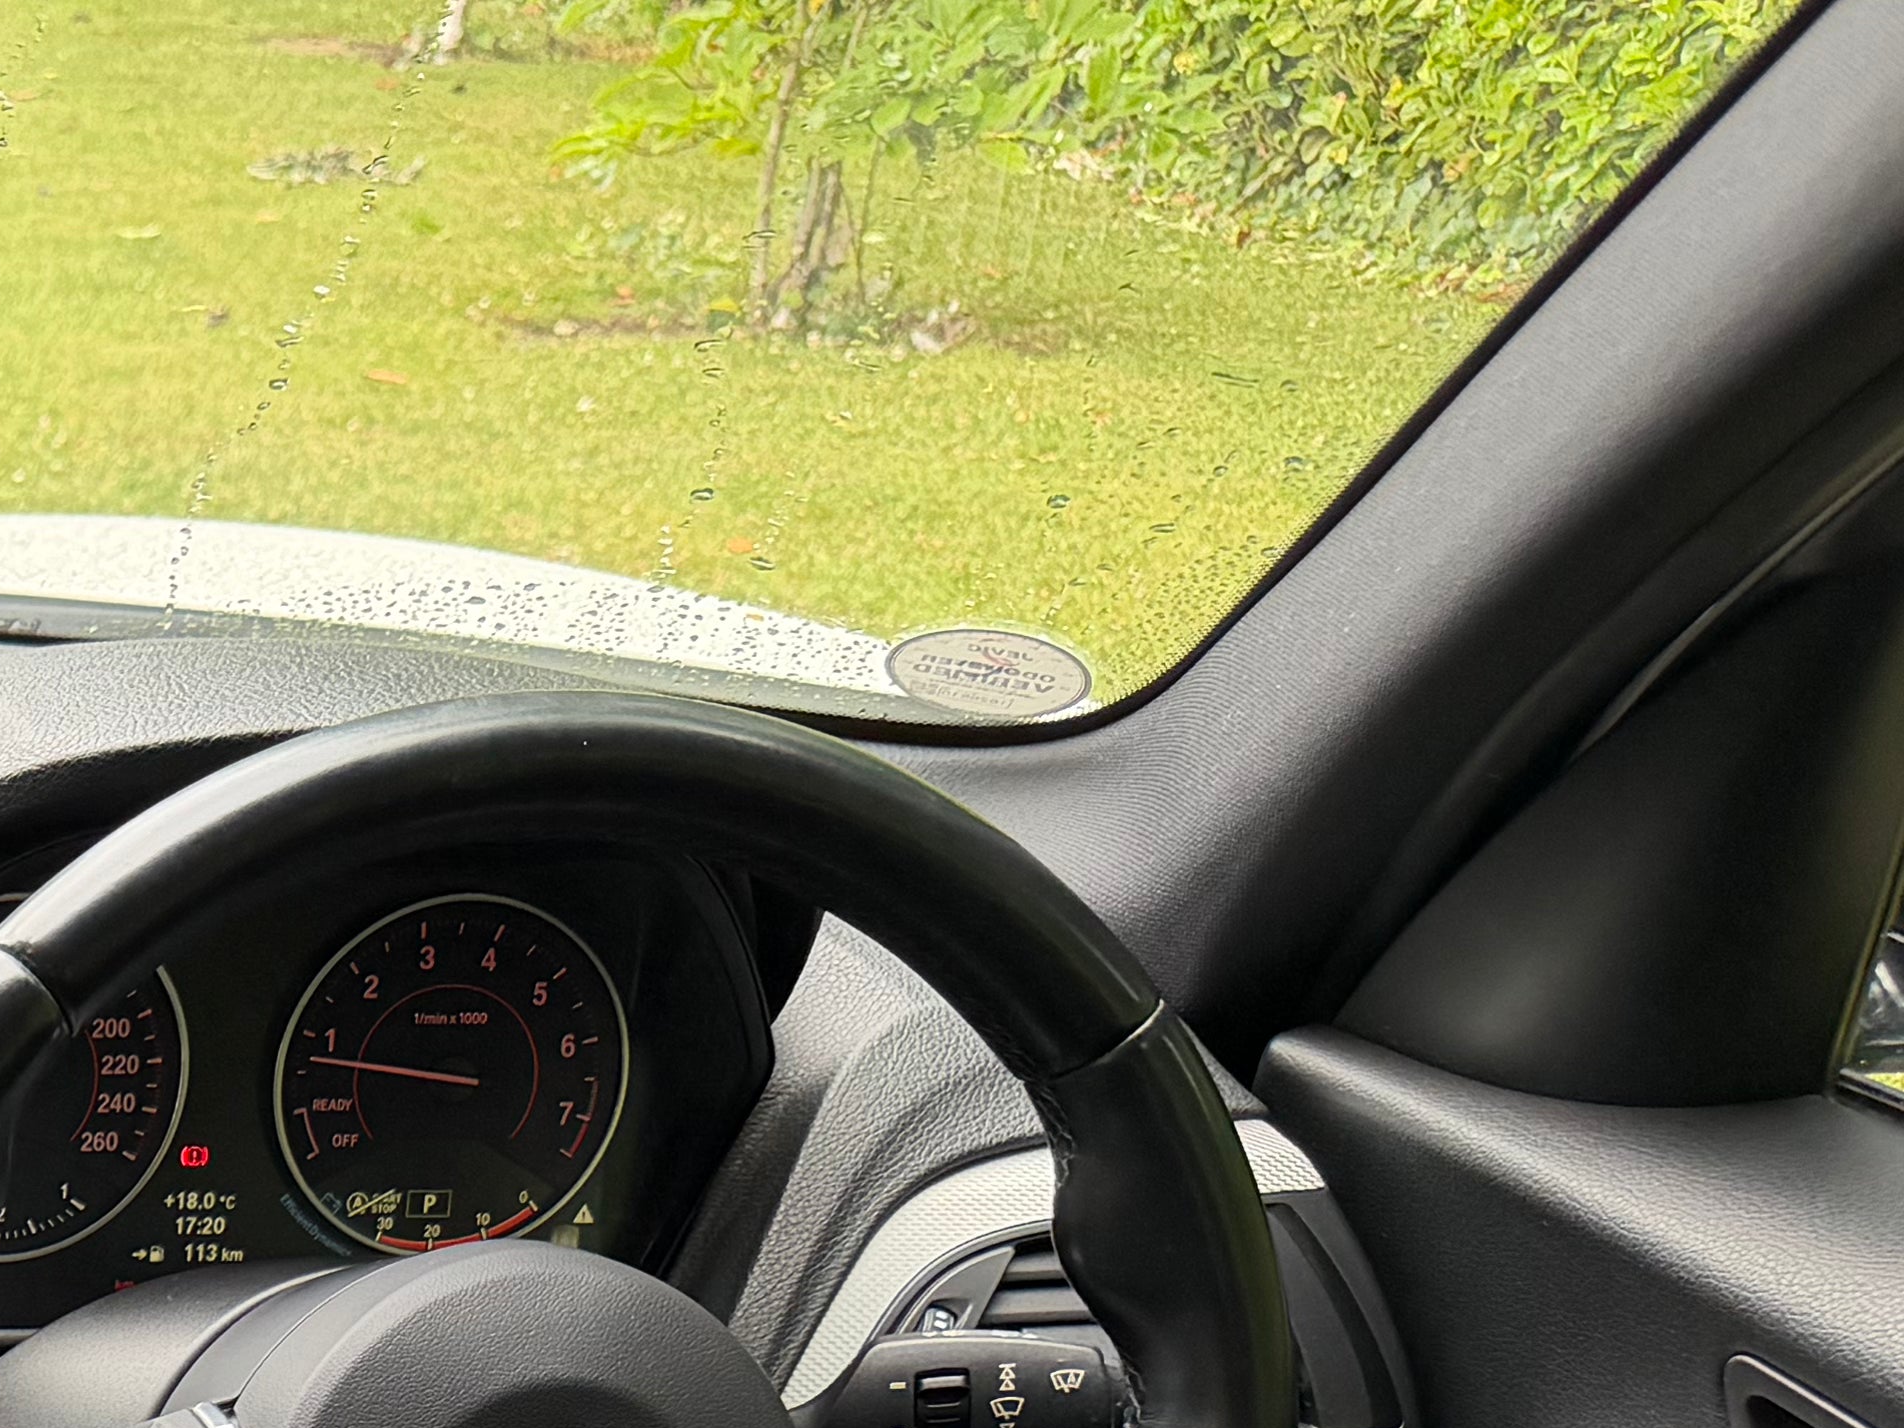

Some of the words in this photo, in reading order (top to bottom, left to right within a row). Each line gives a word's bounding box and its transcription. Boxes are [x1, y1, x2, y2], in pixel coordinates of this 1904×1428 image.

[420, 945, 435, 970] 3
[481, 947, 496, 972] 4
[363, 974, 379, 1000] 2
[533, 981, 548, 1006] 5
[459, 1012, 488, 1024] 1000
[92, 1018, 131, 1039] 200
[324, 1028, 336, 1052] 1
[560, 1033, 576, 1058] 6
[101, 1055, 140, 1075] 220
[97, 1093, 136, 1113] 240
[312, 1098, 354, 1112] READY
[559, 1101, 574, 1126] 7
[80, 1132, 119, 1152] 260
[331, 1134, 359, 1148] OFF
[163, 1191, 215, 1211] +18.0
[423, 1195, 436, 1213] P
[175, 1216, 226, 1236] 17:20
[376, 1217, 393, 1230] 30
[476, 1213, 491, 1226] 10
[423, 1225, 441, 1238] 20
[184, 1244, 217, 1263] 113
[221, 1248, 244, 1263] km
